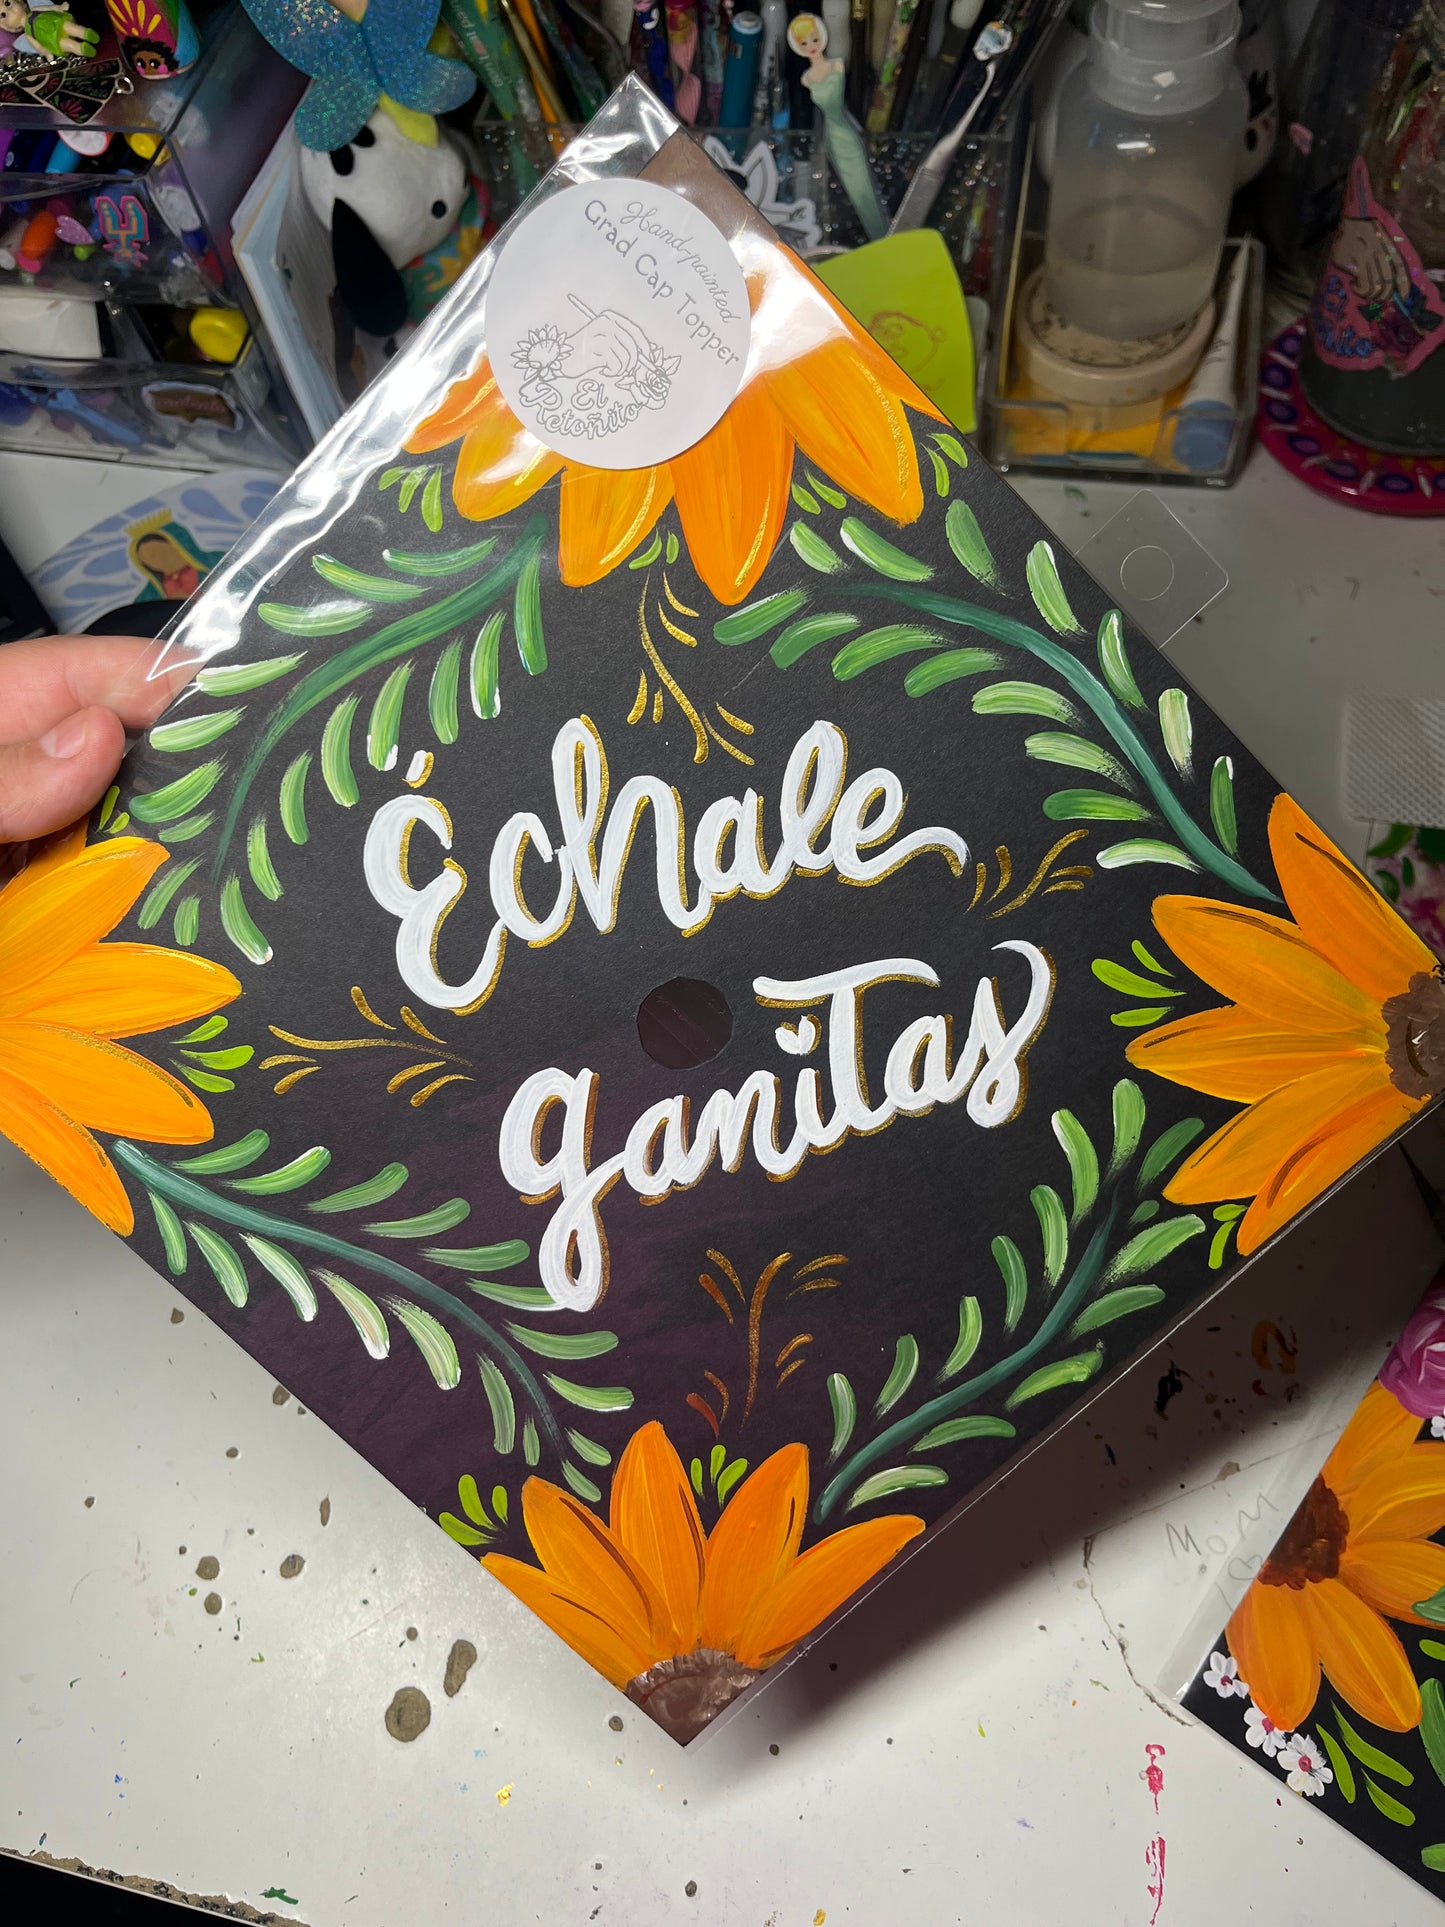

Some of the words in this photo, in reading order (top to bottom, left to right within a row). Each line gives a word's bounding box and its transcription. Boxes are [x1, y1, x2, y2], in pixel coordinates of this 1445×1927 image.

[584, 199, 639, 258] Grad
[634, 253, 674, 299] Cap
[676, 292, 740, 366] Topper
[619, 201, 742, 324] Hand-painted
[518, 377, 644, 440] Retoñito
[570, 378, 609, 411] El
[363, 713, 970, 1016] Échale
